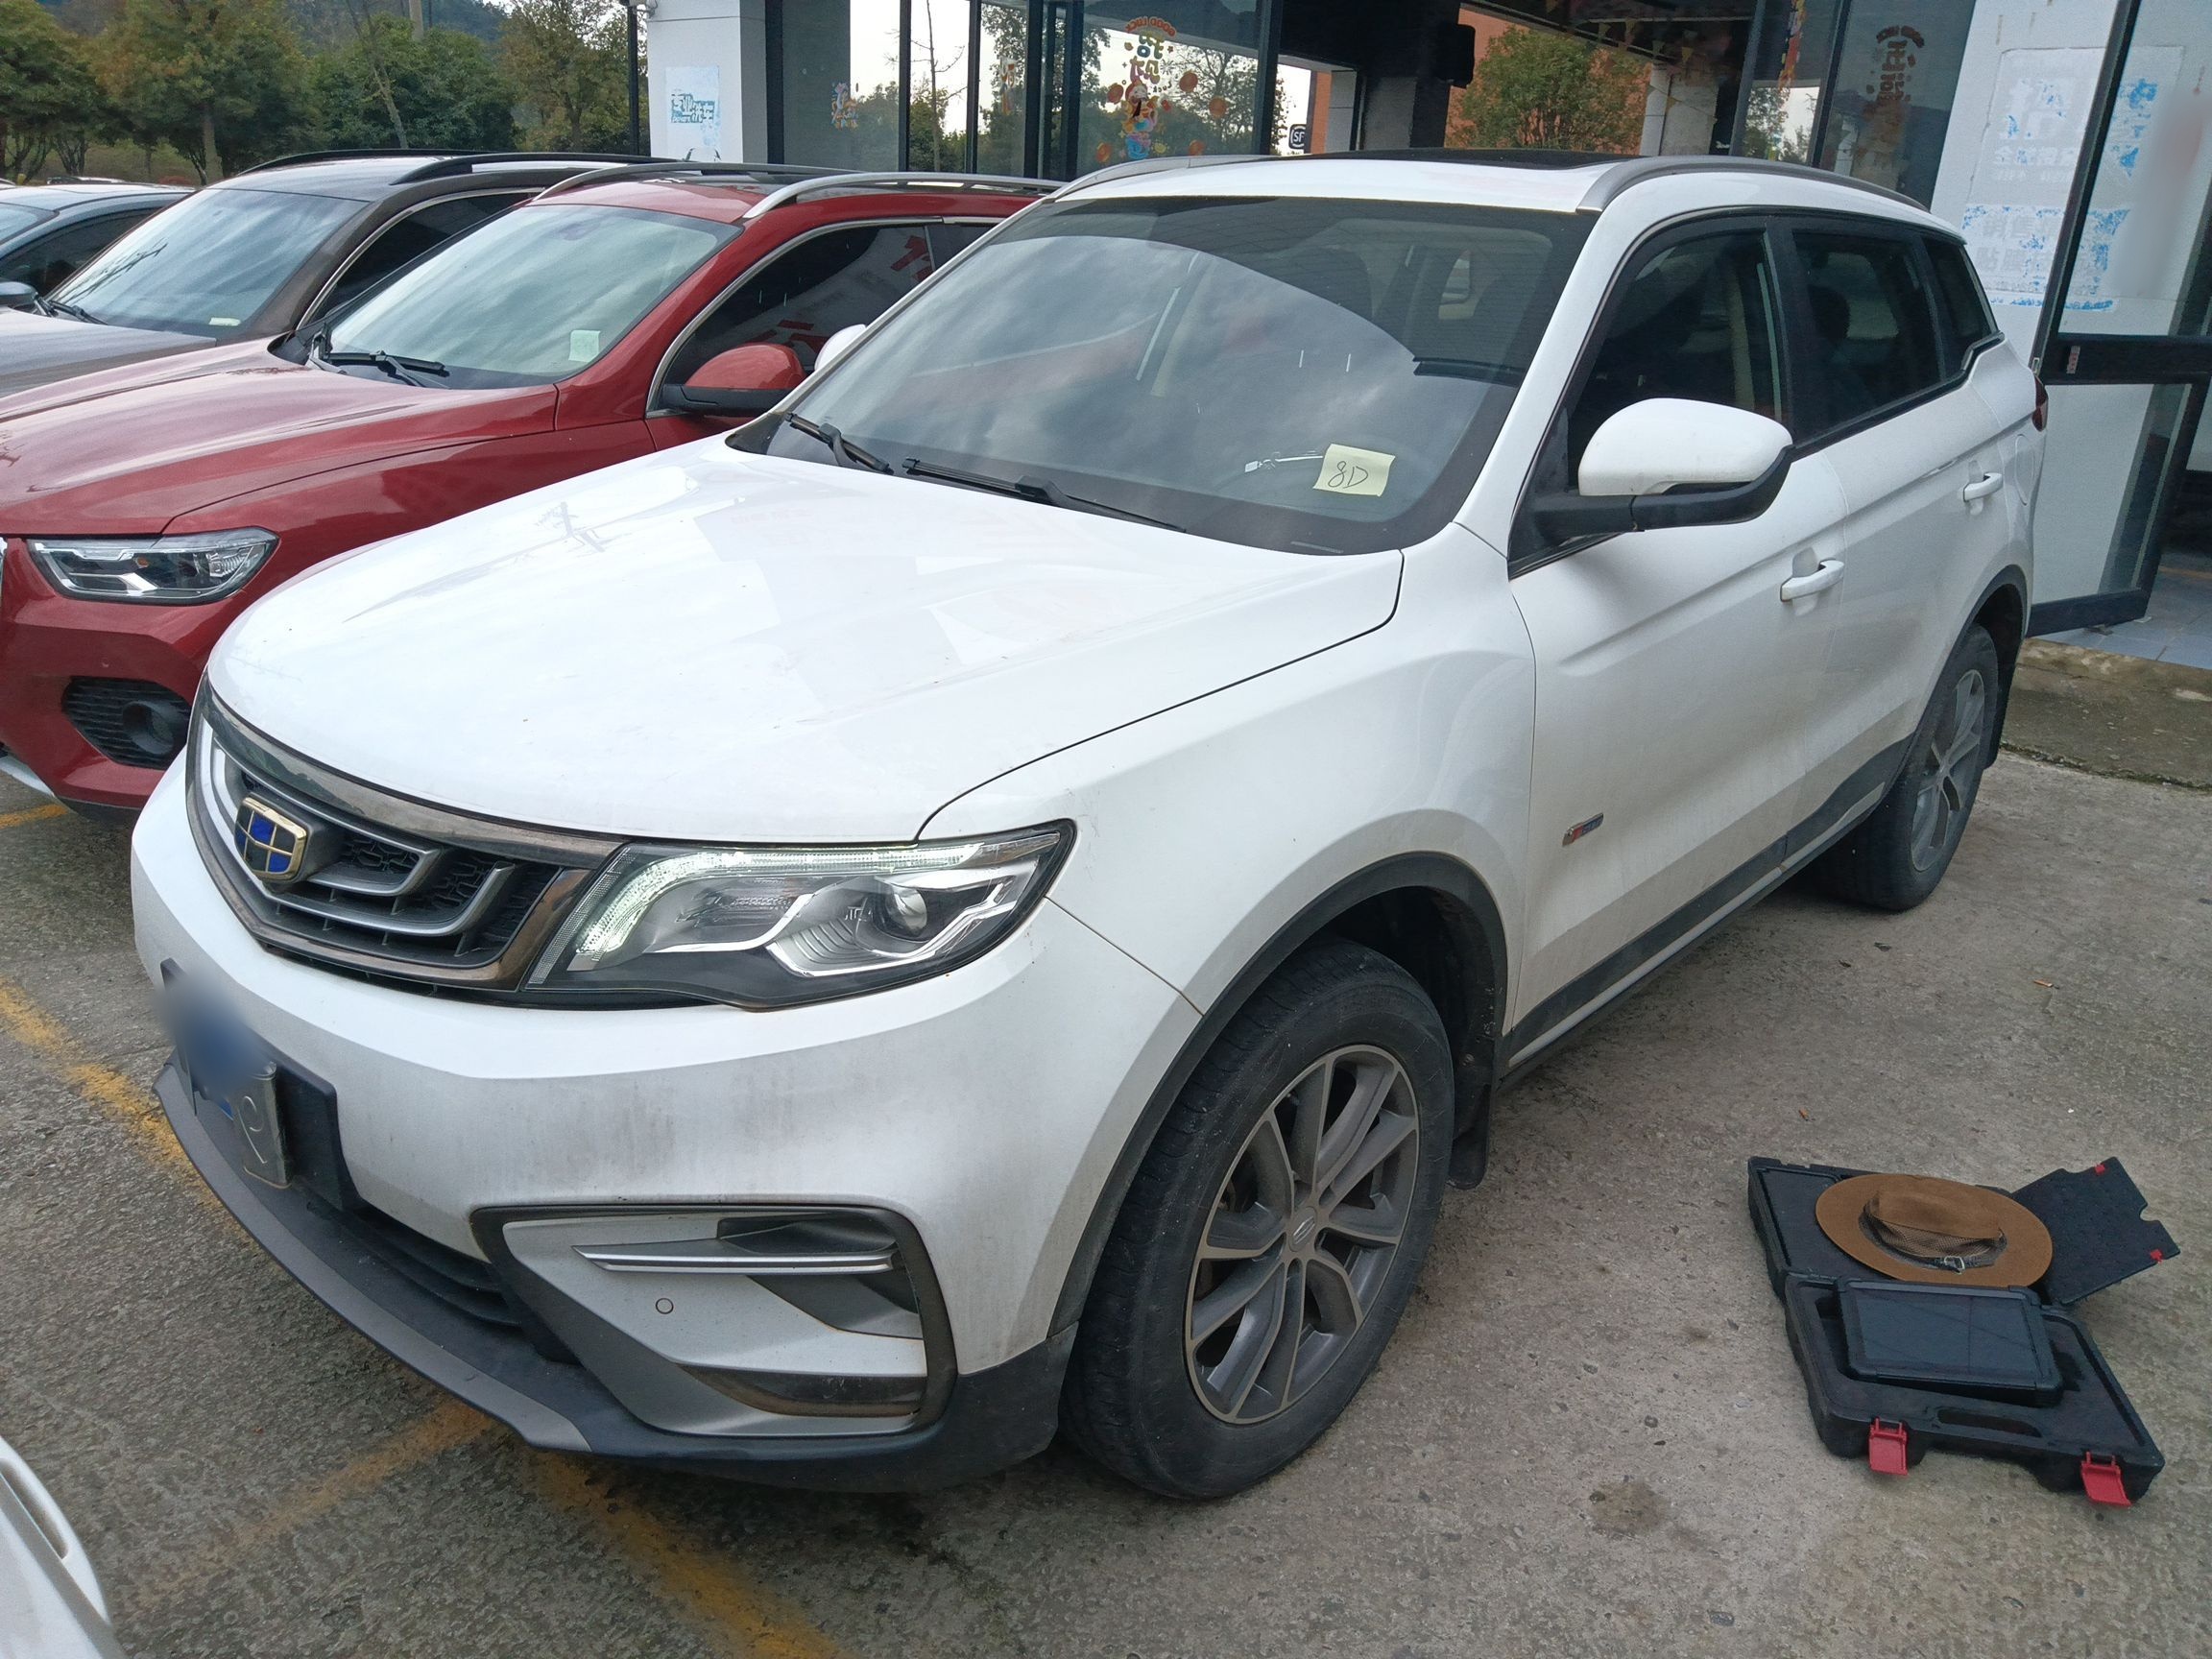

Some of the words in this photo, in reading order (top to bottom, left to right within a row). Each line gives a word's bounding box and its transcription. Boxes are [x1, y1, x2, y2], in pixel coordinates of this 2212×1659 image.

[671, 94, 714, 124] 专业洗车
[1293, 132, 1306, 142] SF
[1328, 461, 1368, 489] 8D
